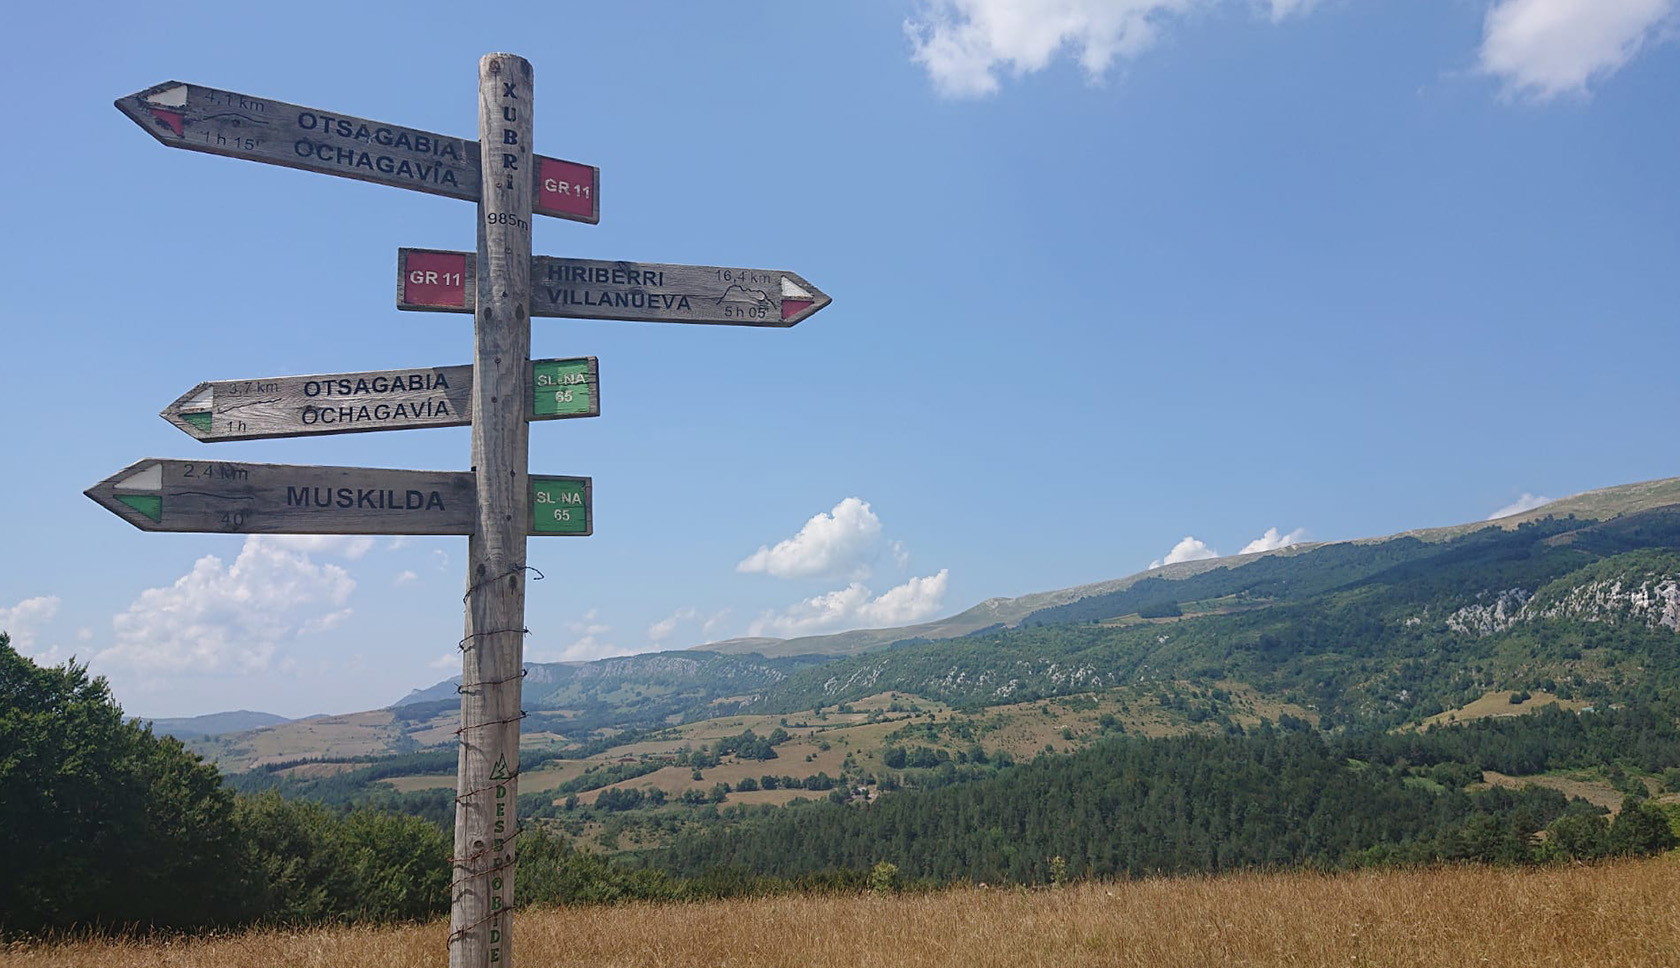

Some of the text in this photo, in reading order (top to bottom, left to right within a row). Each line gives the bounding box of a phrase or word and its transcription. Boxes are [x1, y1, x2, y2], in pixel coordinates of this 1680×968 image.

[239, 97, 265, 112] km
[216, 134, 227, 146] h
[298, 112, 460, 161] OTSAGABIA
[294, 139, 459, 187] OCHAGAVÍA
[544, 178, 590, 199] GR 11
[487, 212, 528, 231] 985m
[410, 270, 460, 286] GR 11
[549, 265, 664, 286] HIRIBERRI
[716, 269, 771, 283] 16,4 km
[547, 288, 691, 310] VILLANUEVA
[724, 306, 733, 317] 5
[736, 307, 744, 318] h
[229, 381, 279, 394] 3,7 km
[304, 373, 449, 397] OTSAGABIA
[555, 390, 573, 402] 65
[302, 397, 450, 425] OCHAGAVÍA
[226, 420, 247, 432] 1 h
[183, 463, 212, 479] 2,4
[287, 486, 446, 511] MUSKILDA
[554, 508, 570, 521] 65
